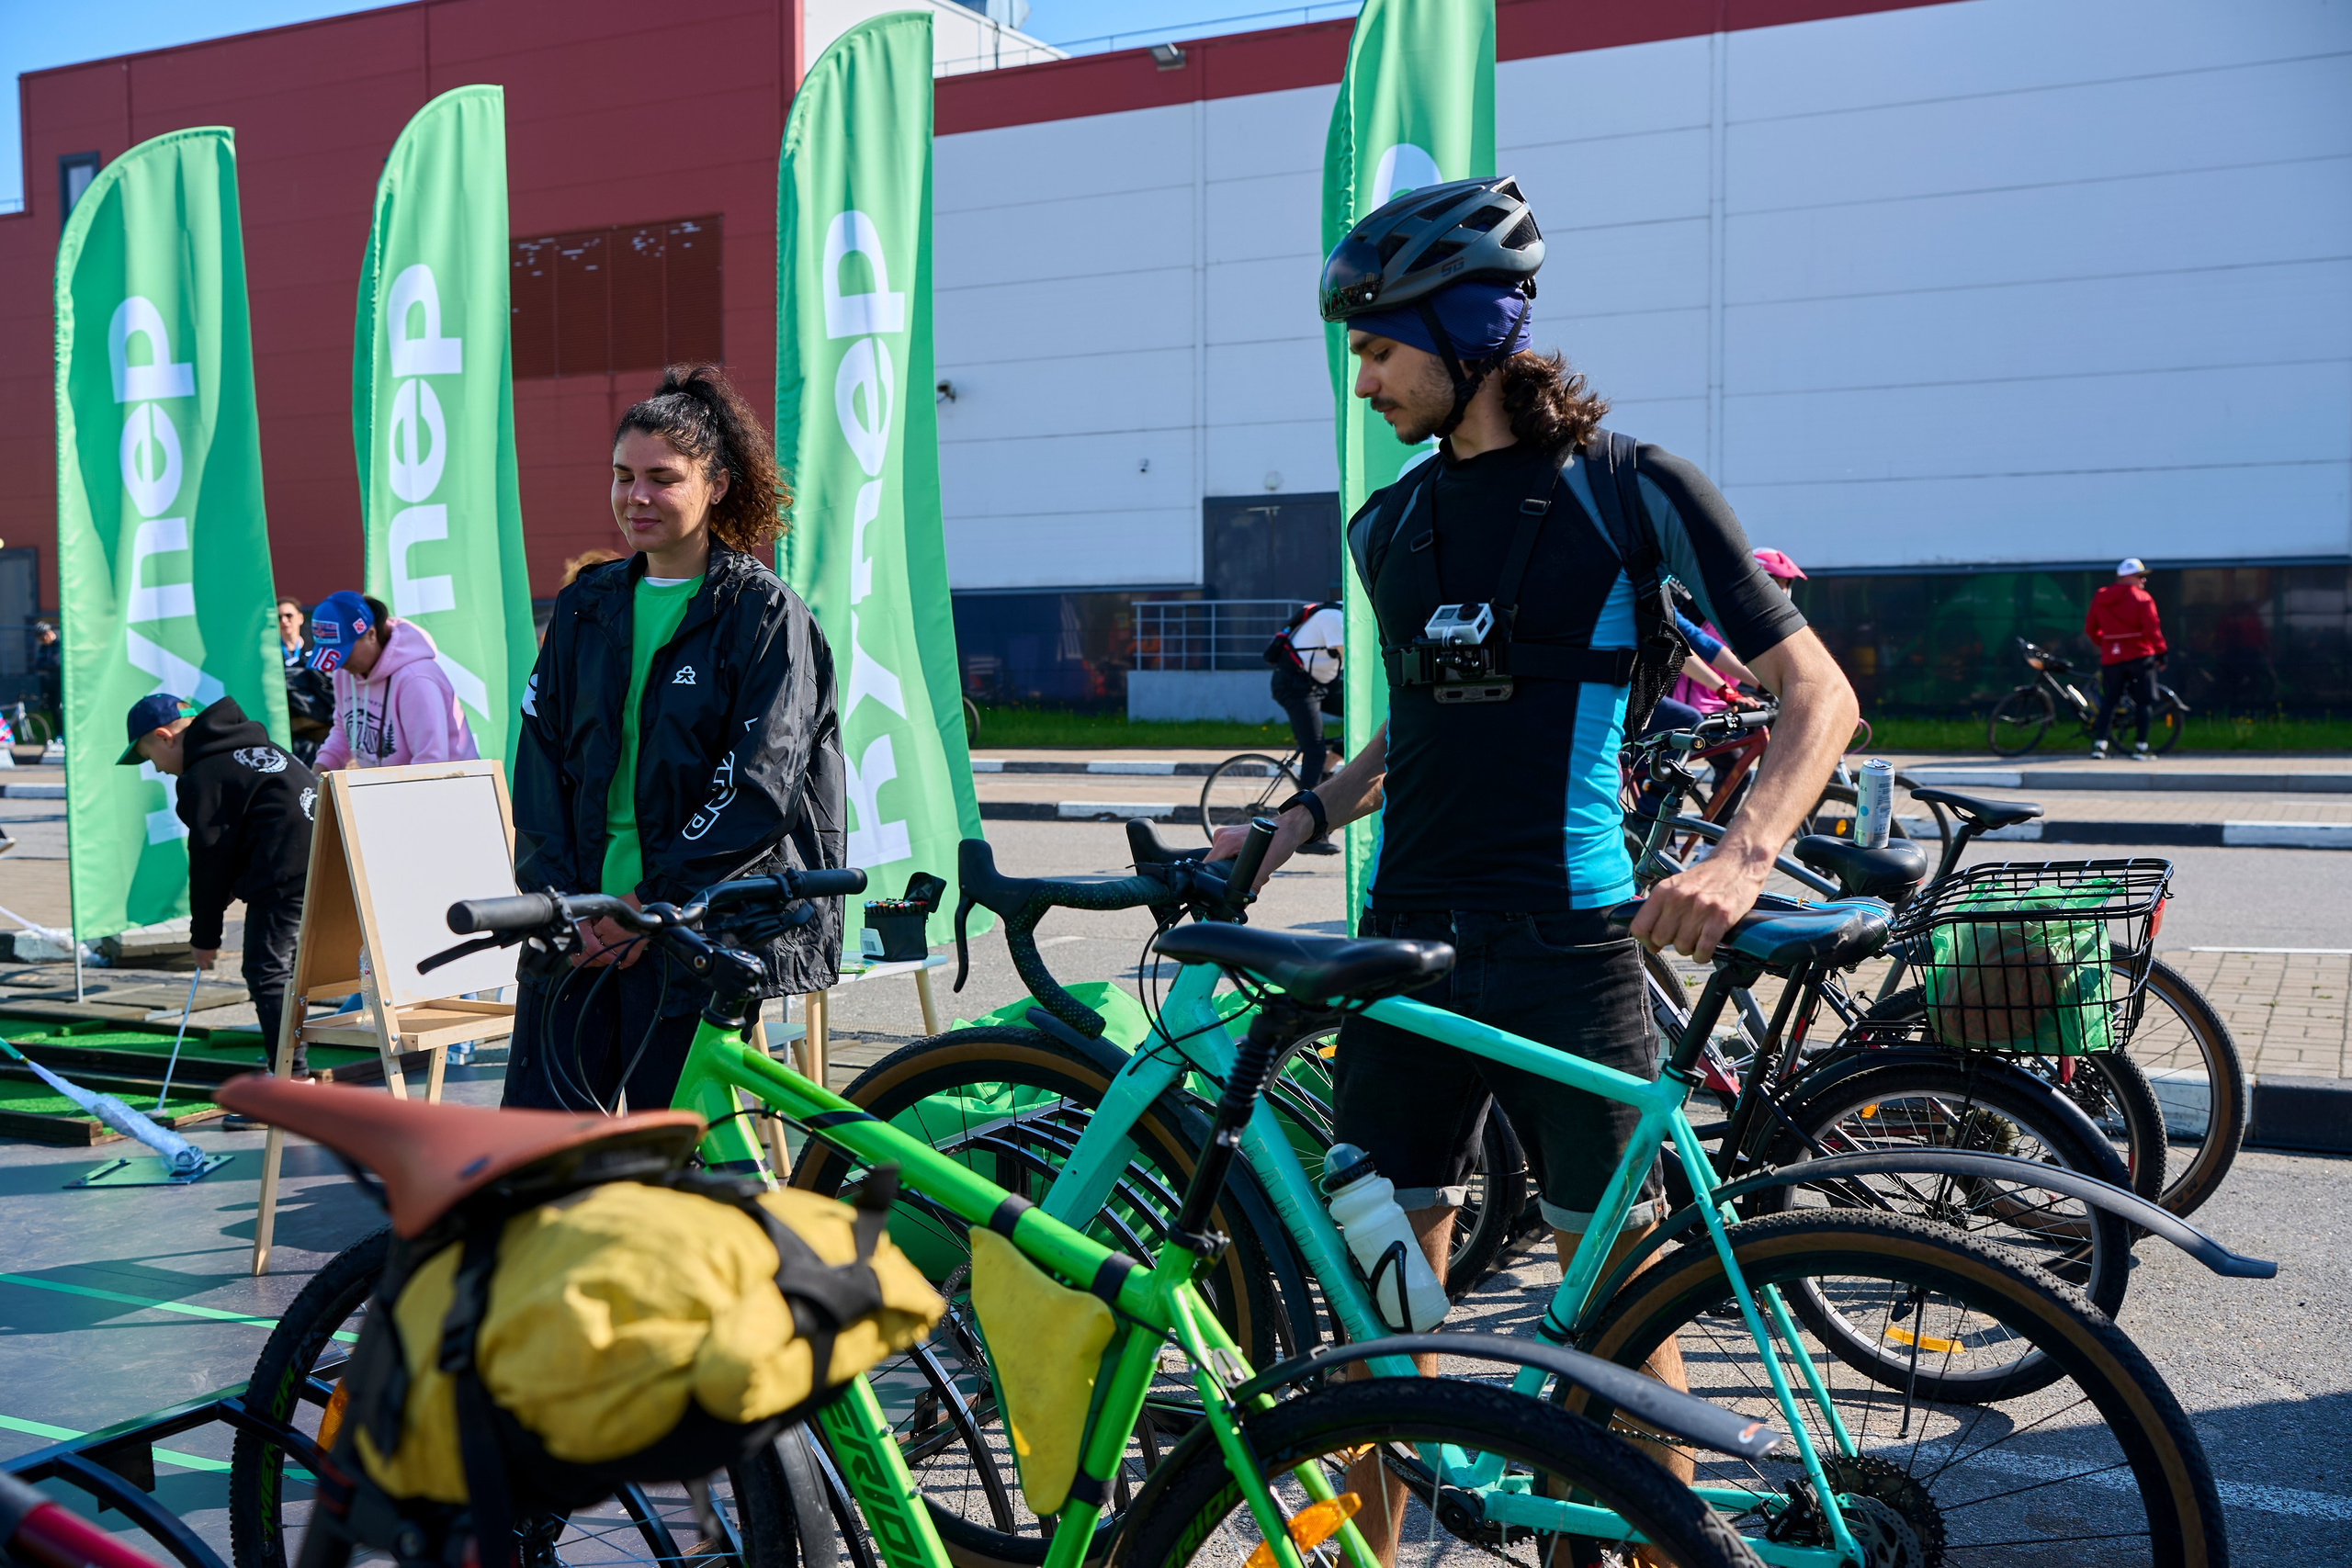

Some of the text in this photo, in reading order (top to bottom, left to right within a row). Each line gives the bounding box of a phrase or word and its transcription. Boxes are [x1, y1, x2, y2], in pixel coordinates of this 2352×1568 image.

[386, 263, 491, 759] пер
[311, 647, 342, 672] 16
[1243, 1132, 1366, 1339] EABOARD
[261, 1365, 295, 1540] MERDA
[828, 1396, 922, 1568] ERID
